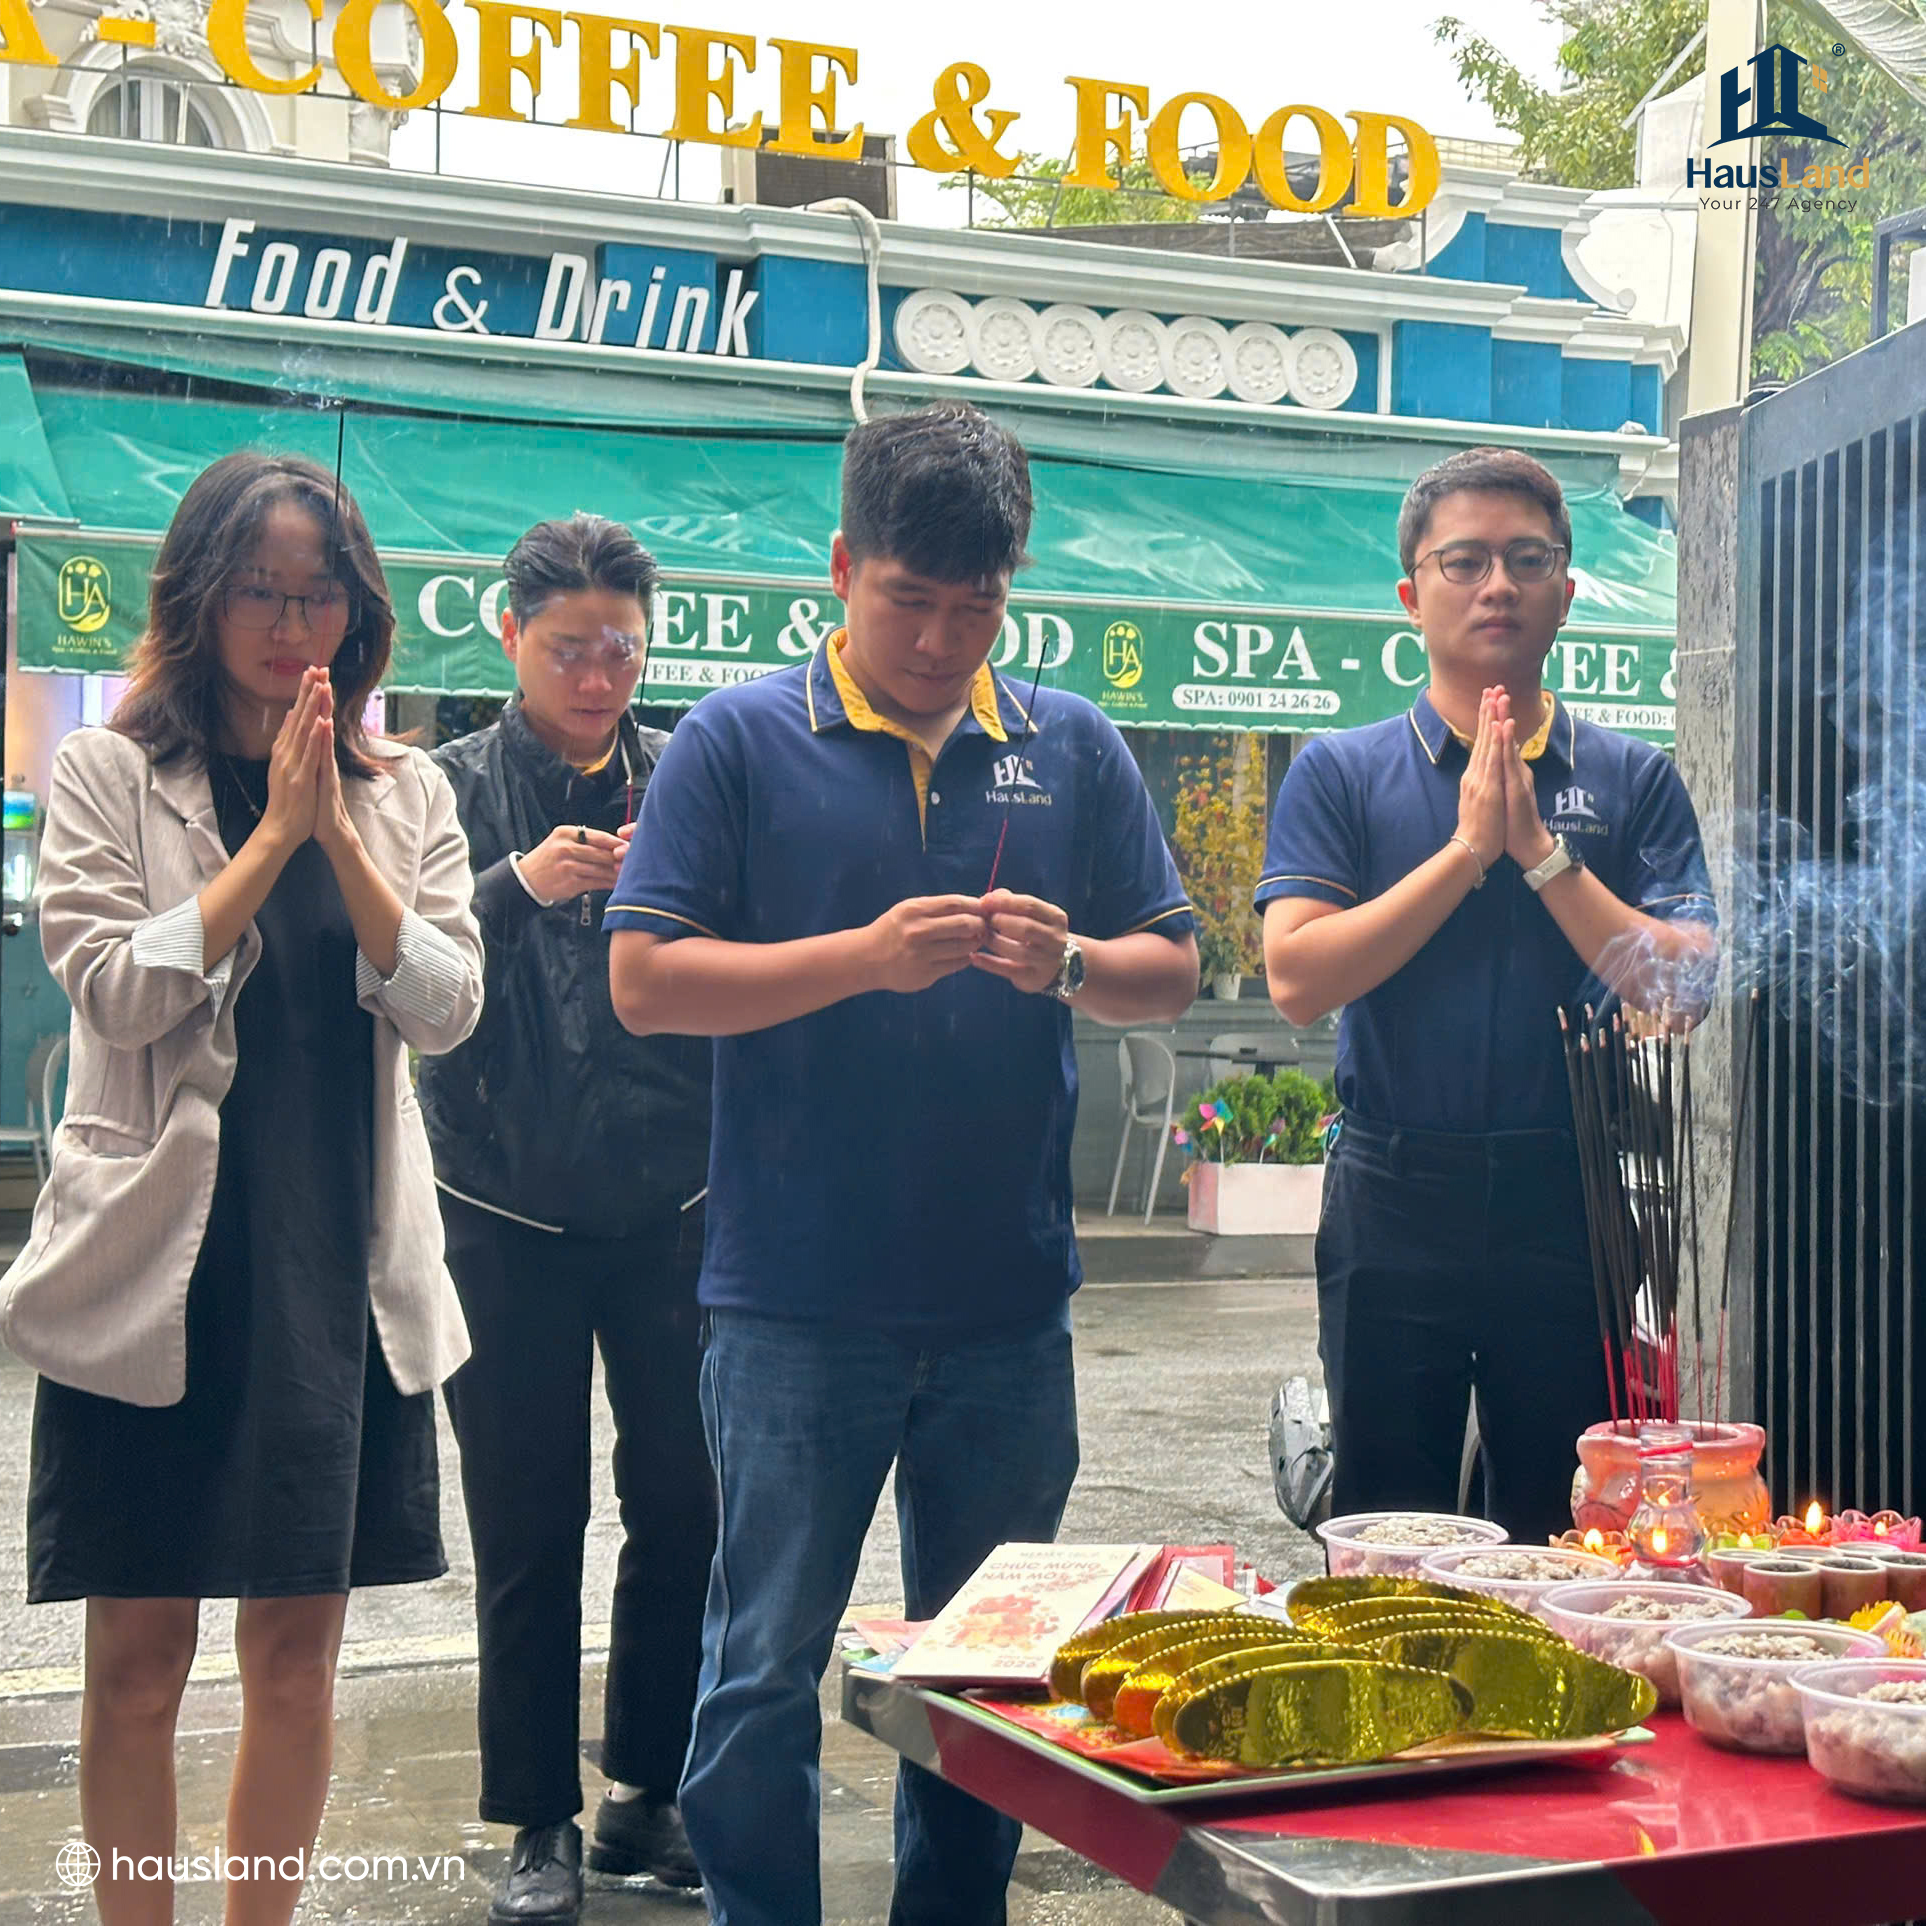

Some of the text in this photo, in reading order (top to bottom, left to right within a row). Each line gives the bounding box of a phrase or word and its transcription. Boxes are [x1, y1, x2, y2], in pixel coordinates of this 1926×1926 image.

[206, 0, 864, 164] COFFEE
[907, 62, 1023, 179] &
[1061, 76, 1442, 218] FOOD
[204, 217, 760, 357] Food & Drink
[776, 598, 836, 657] &
[1193, 620, 1322, 681] SPA
[699, 666, 714, 683] &
[1182, 688, 1331, 710] SPA: 0901 24 26 26
[1616, 709, 1668, 726] FOOD:
